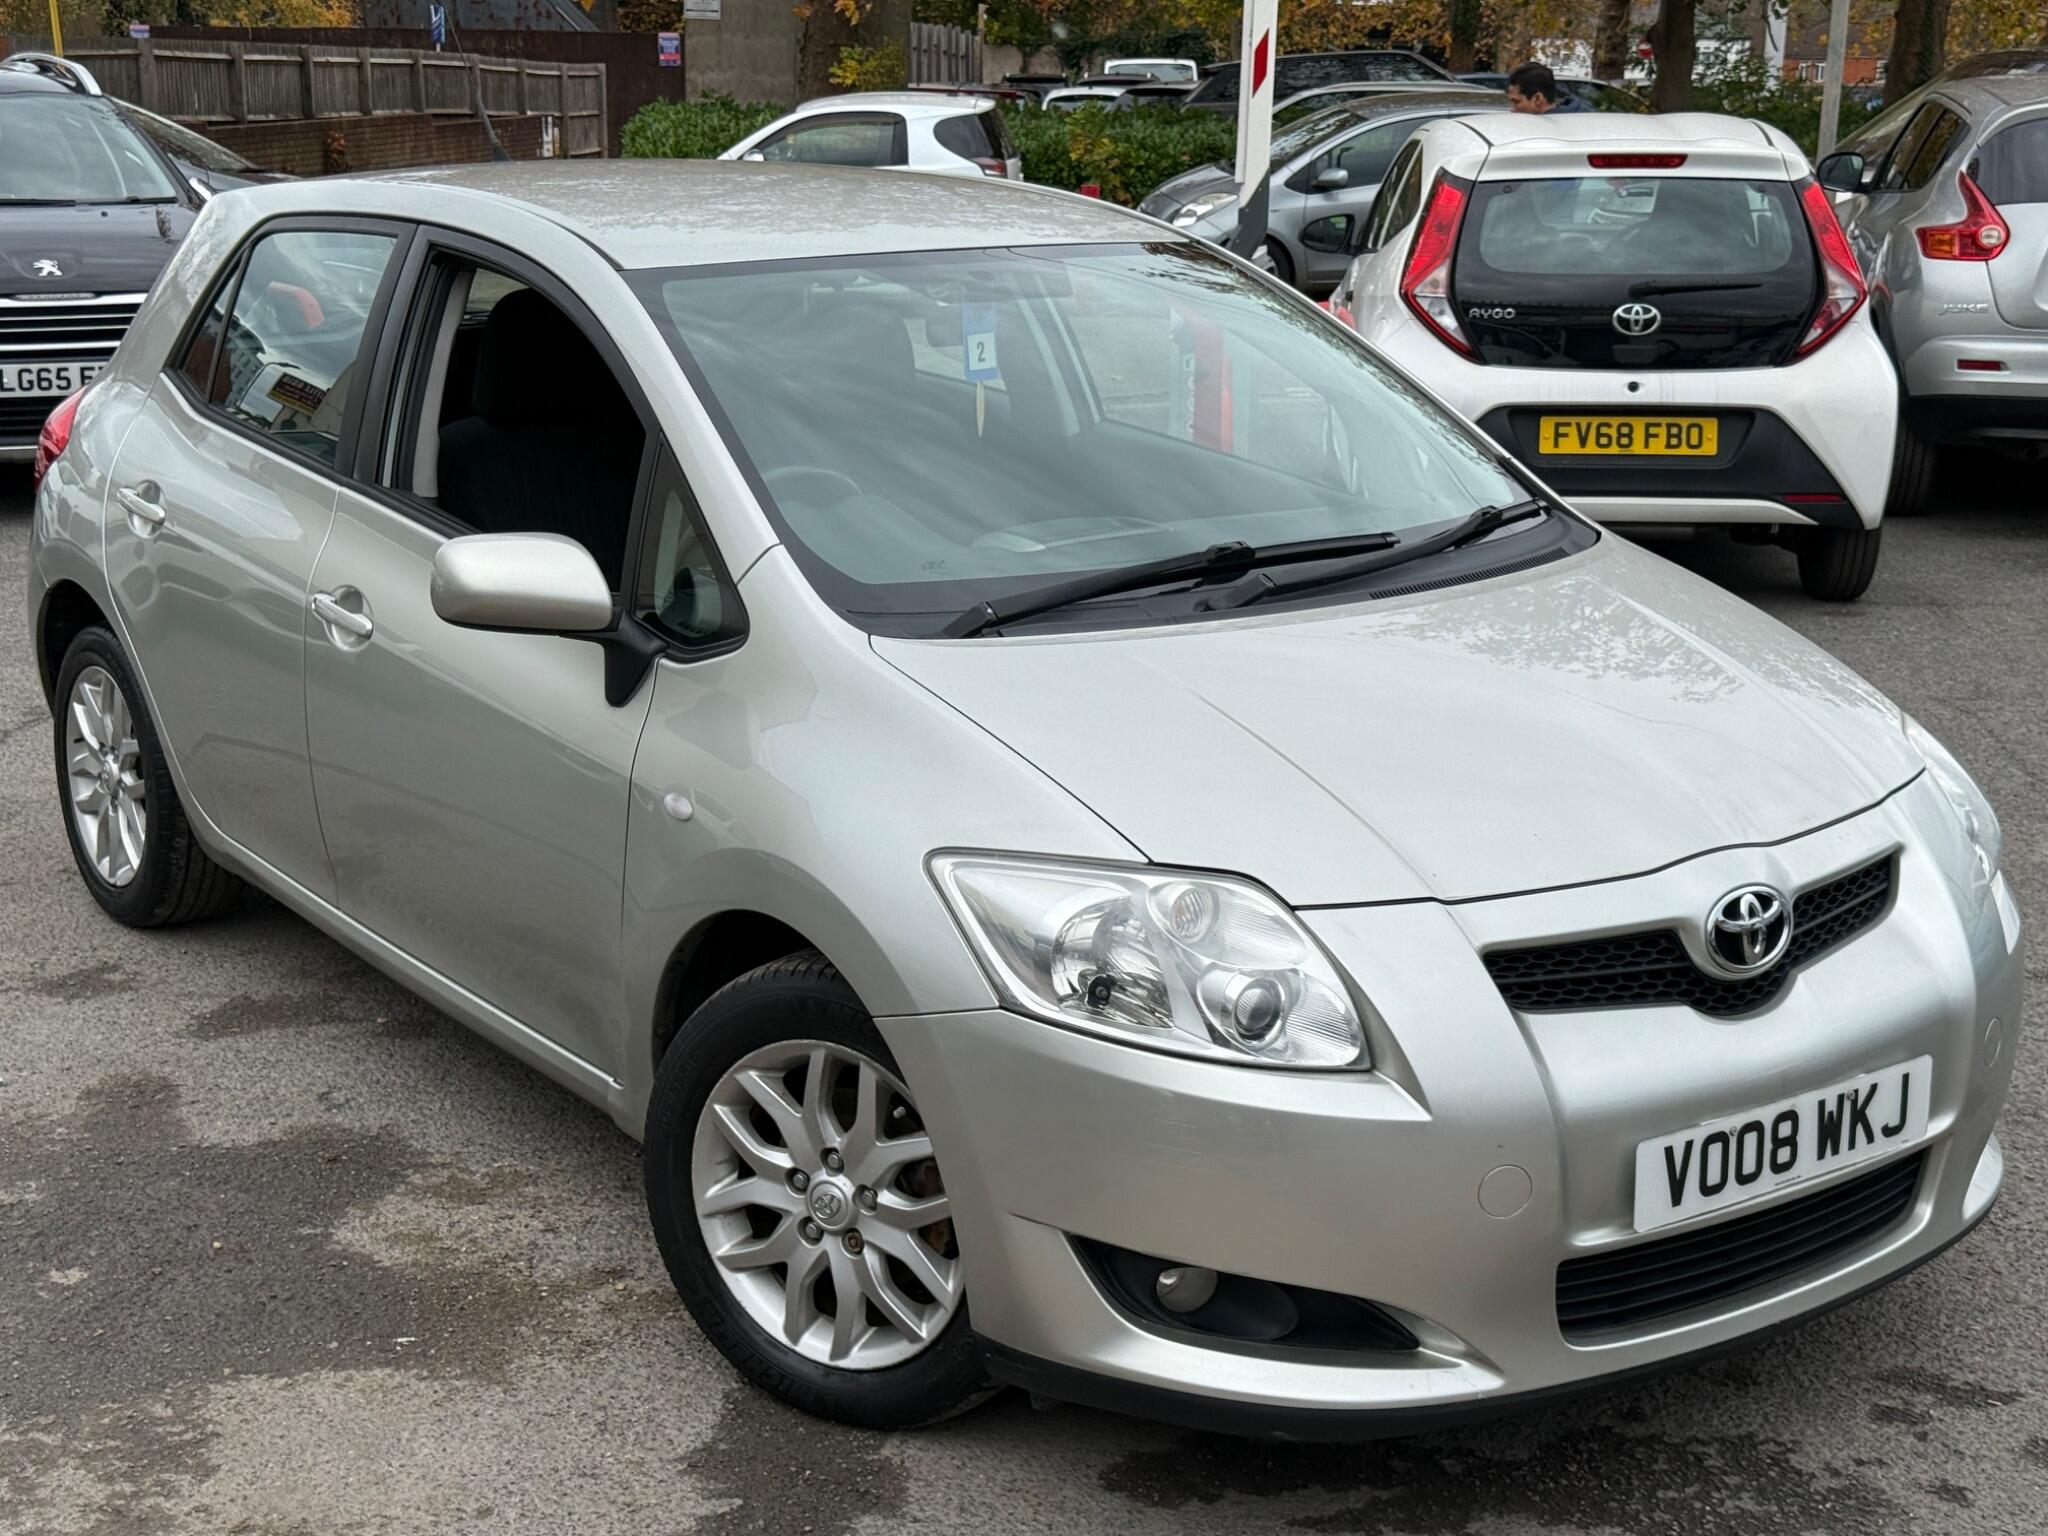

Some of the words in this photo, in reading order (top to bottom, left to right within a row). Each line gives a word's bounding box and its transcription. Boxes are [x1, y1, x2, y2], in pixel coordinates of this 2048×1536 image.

[1469, 307, 1516, 319] AYGO
[976, 341, 986, 363] 2
[0, 367, 72, 392] LG65
[1553, 421, 1634, 449] FV68
[1643, 422, 1704, 450] FBO
[1663, 1109, 1799, 1208] VO08
[1816, 1072, 1910, 1161] WKJ
